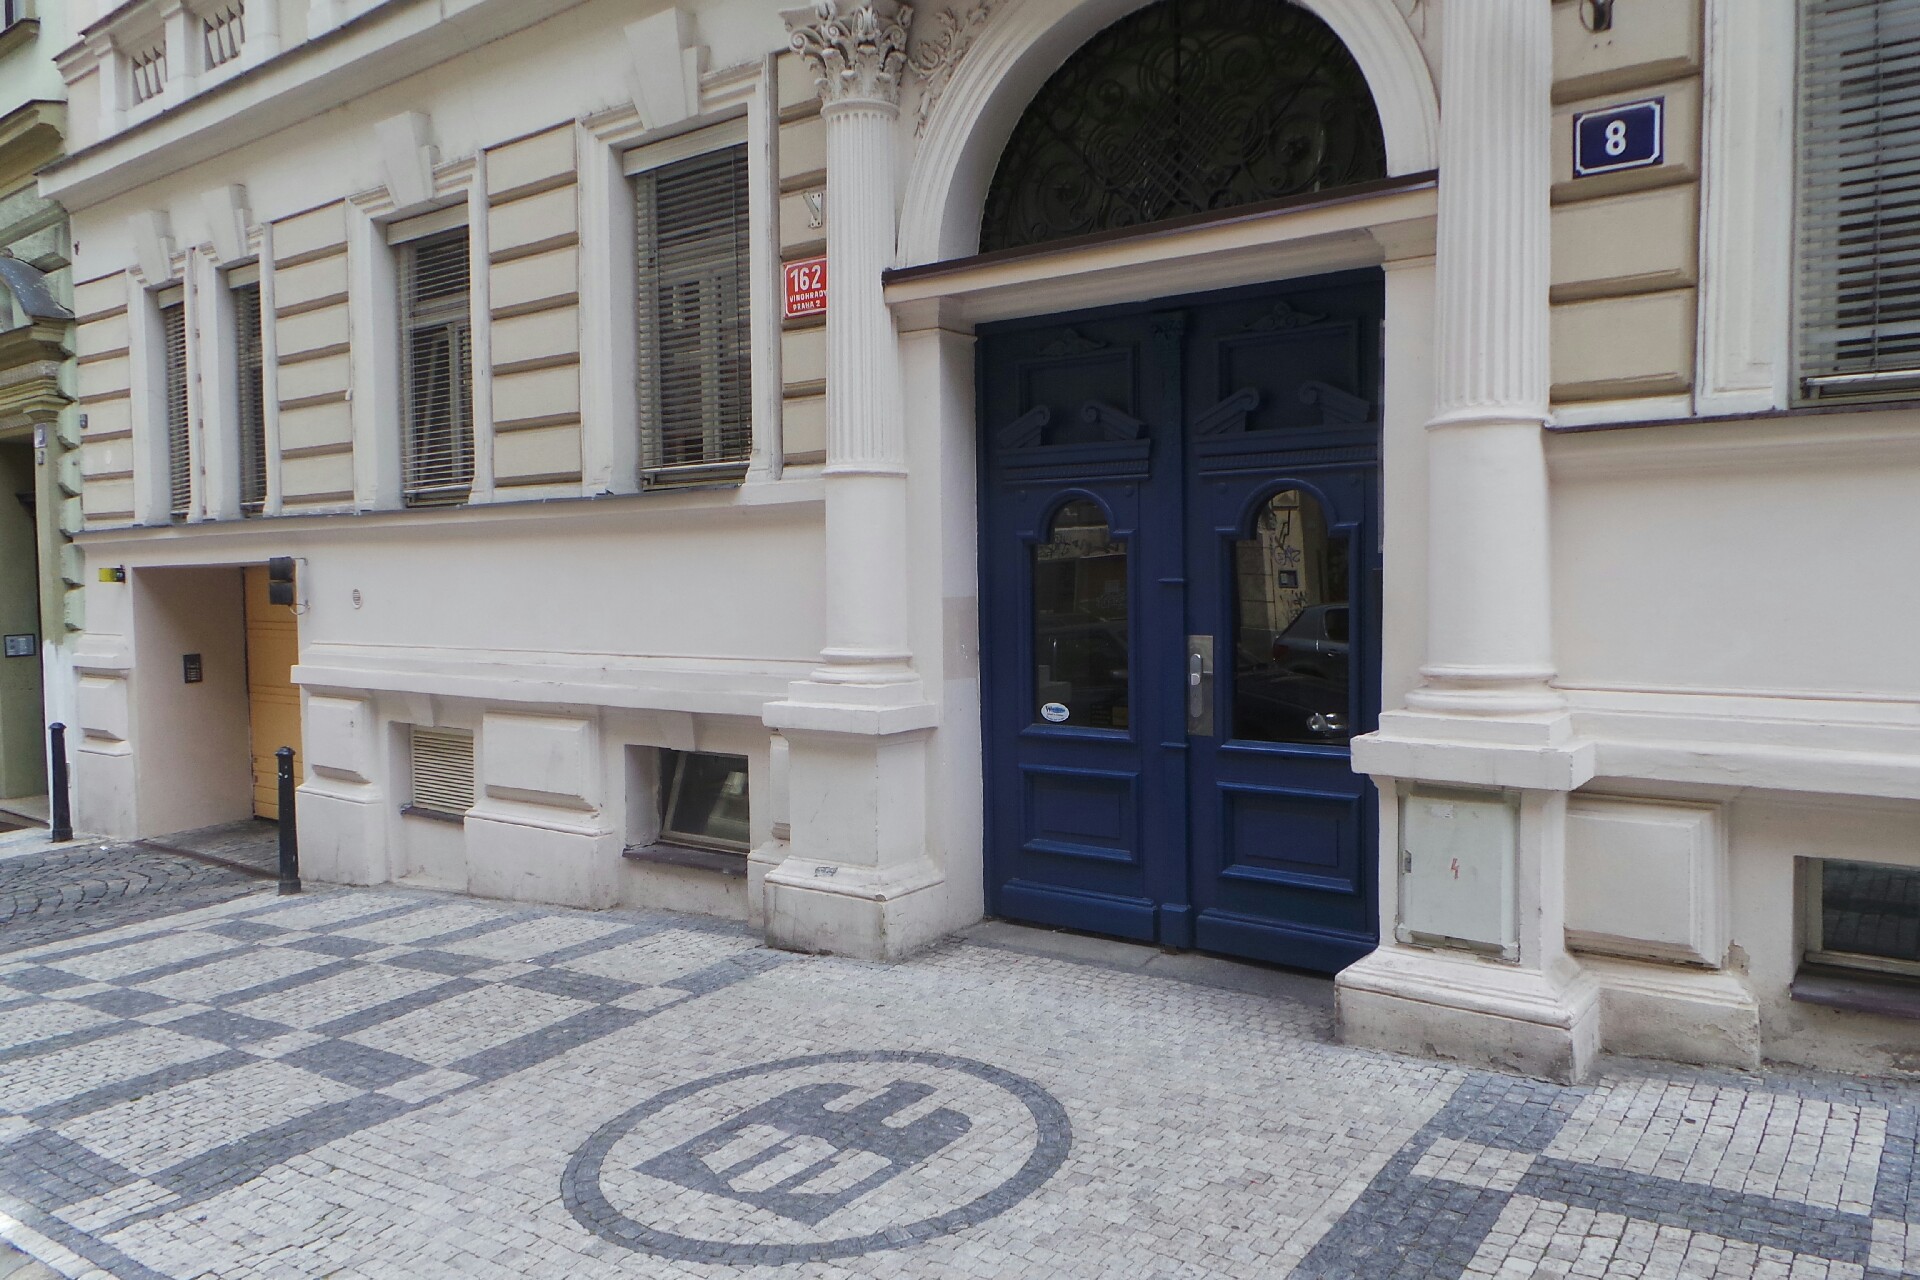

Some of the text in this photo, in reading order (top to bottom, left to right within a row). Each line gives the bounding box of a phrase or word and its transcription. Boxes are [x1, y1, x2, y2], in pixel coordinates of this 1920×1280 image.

[1605, 120, 1626, 156] 8
[790, 265, 821, 292] 162
[793, 301, 815, 311] PRAHA
